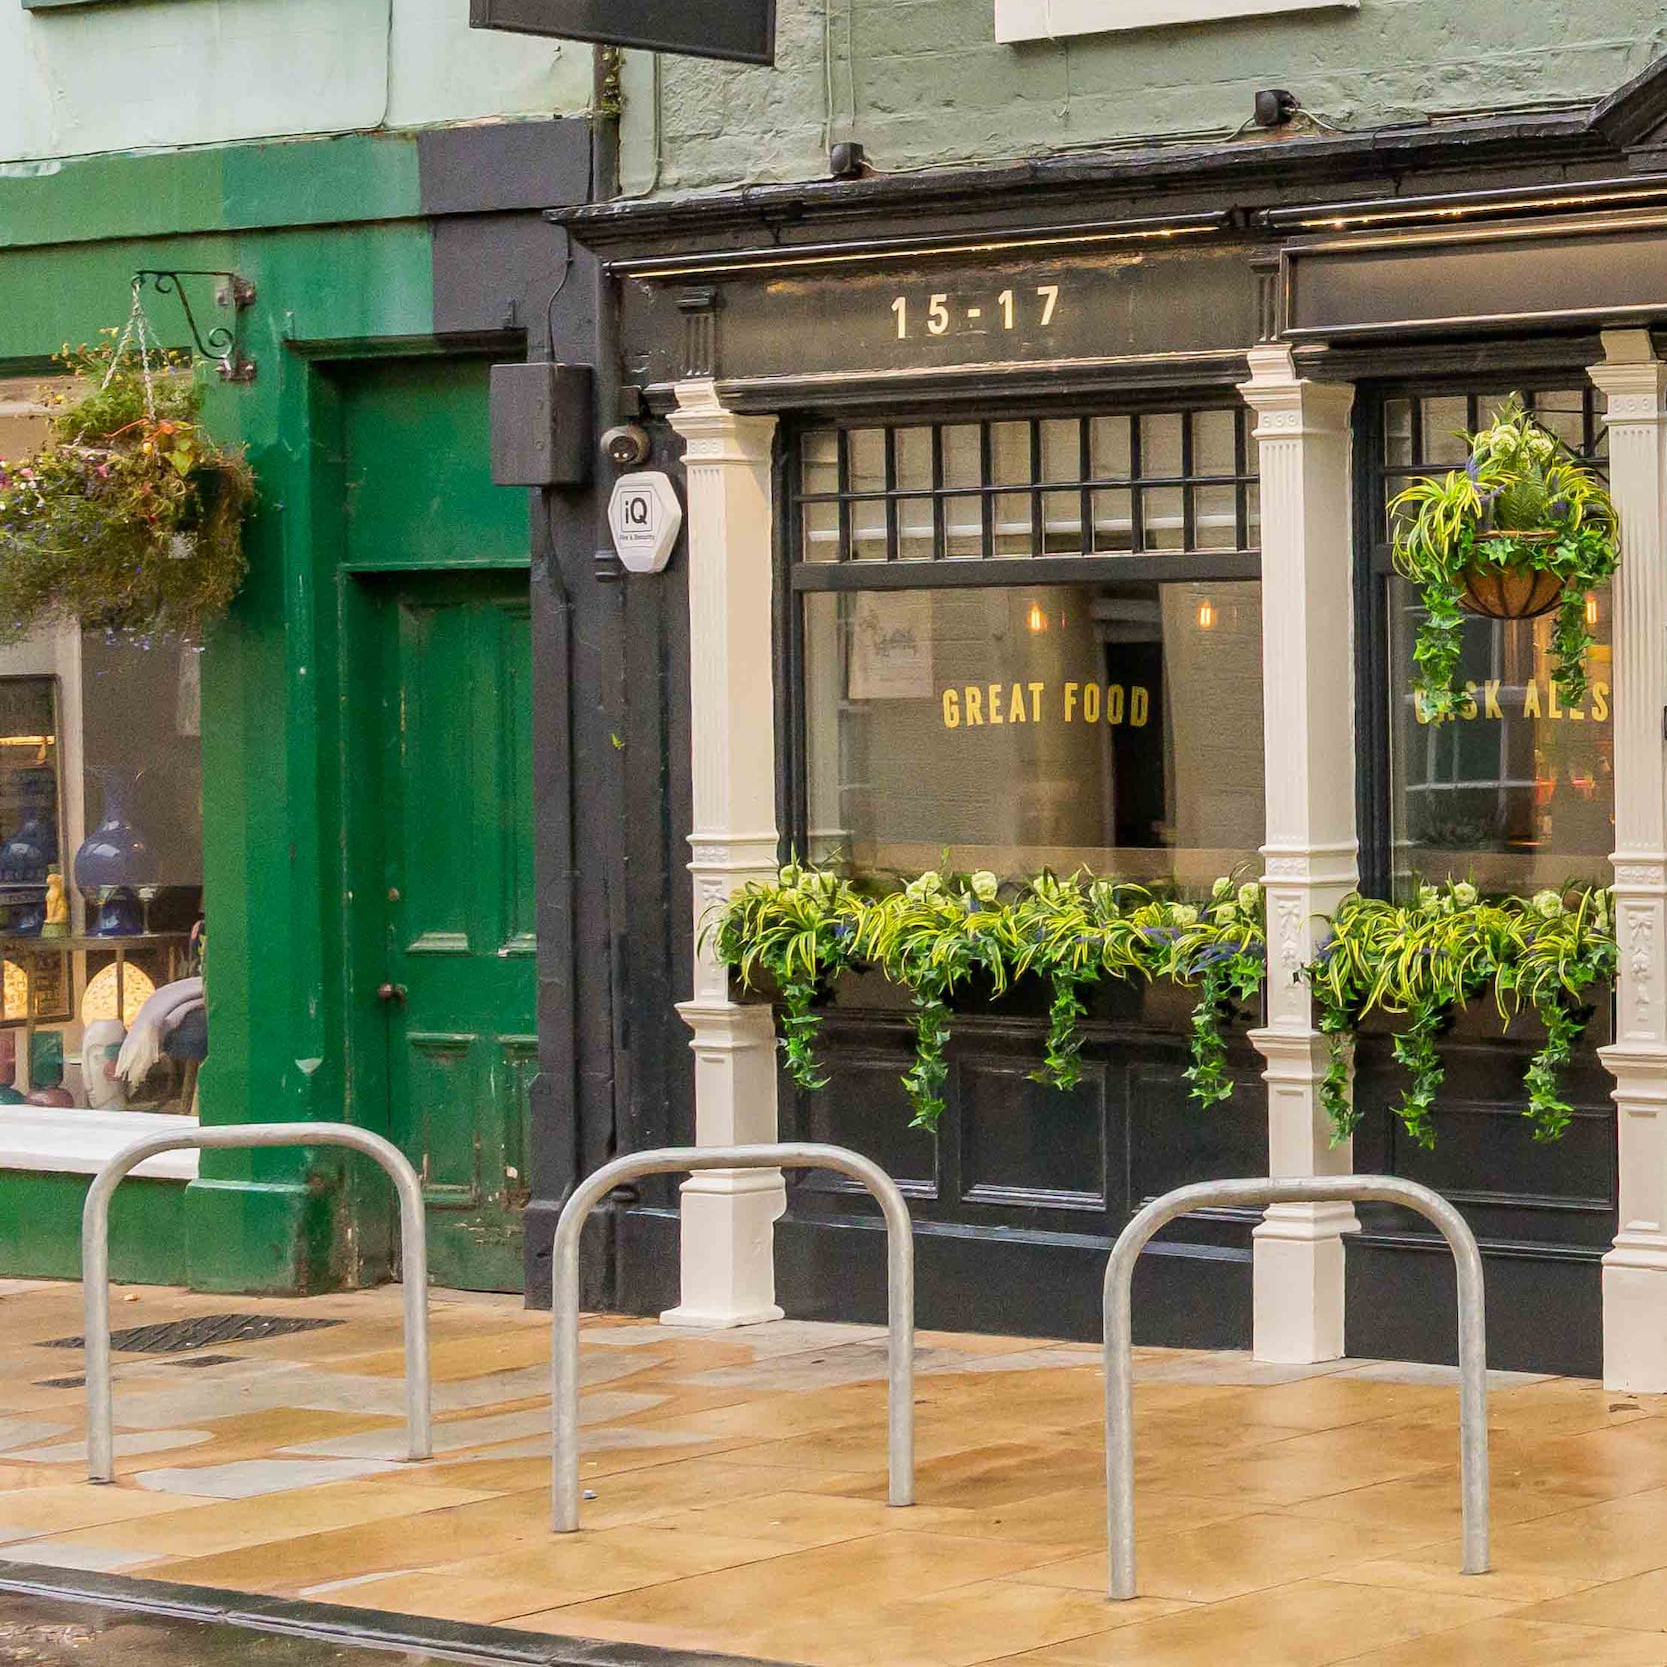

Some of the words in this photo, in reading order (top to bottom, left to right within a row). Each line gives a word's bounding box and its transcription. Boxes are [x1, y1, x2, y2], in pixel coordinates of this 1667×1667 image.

[890, 285, 1060, 339] 15-17
[625, 497, 648, 525] iQ
[942, 681, 1045, 729] GREAT
[1063, 682, 1150, 727] FOOD
